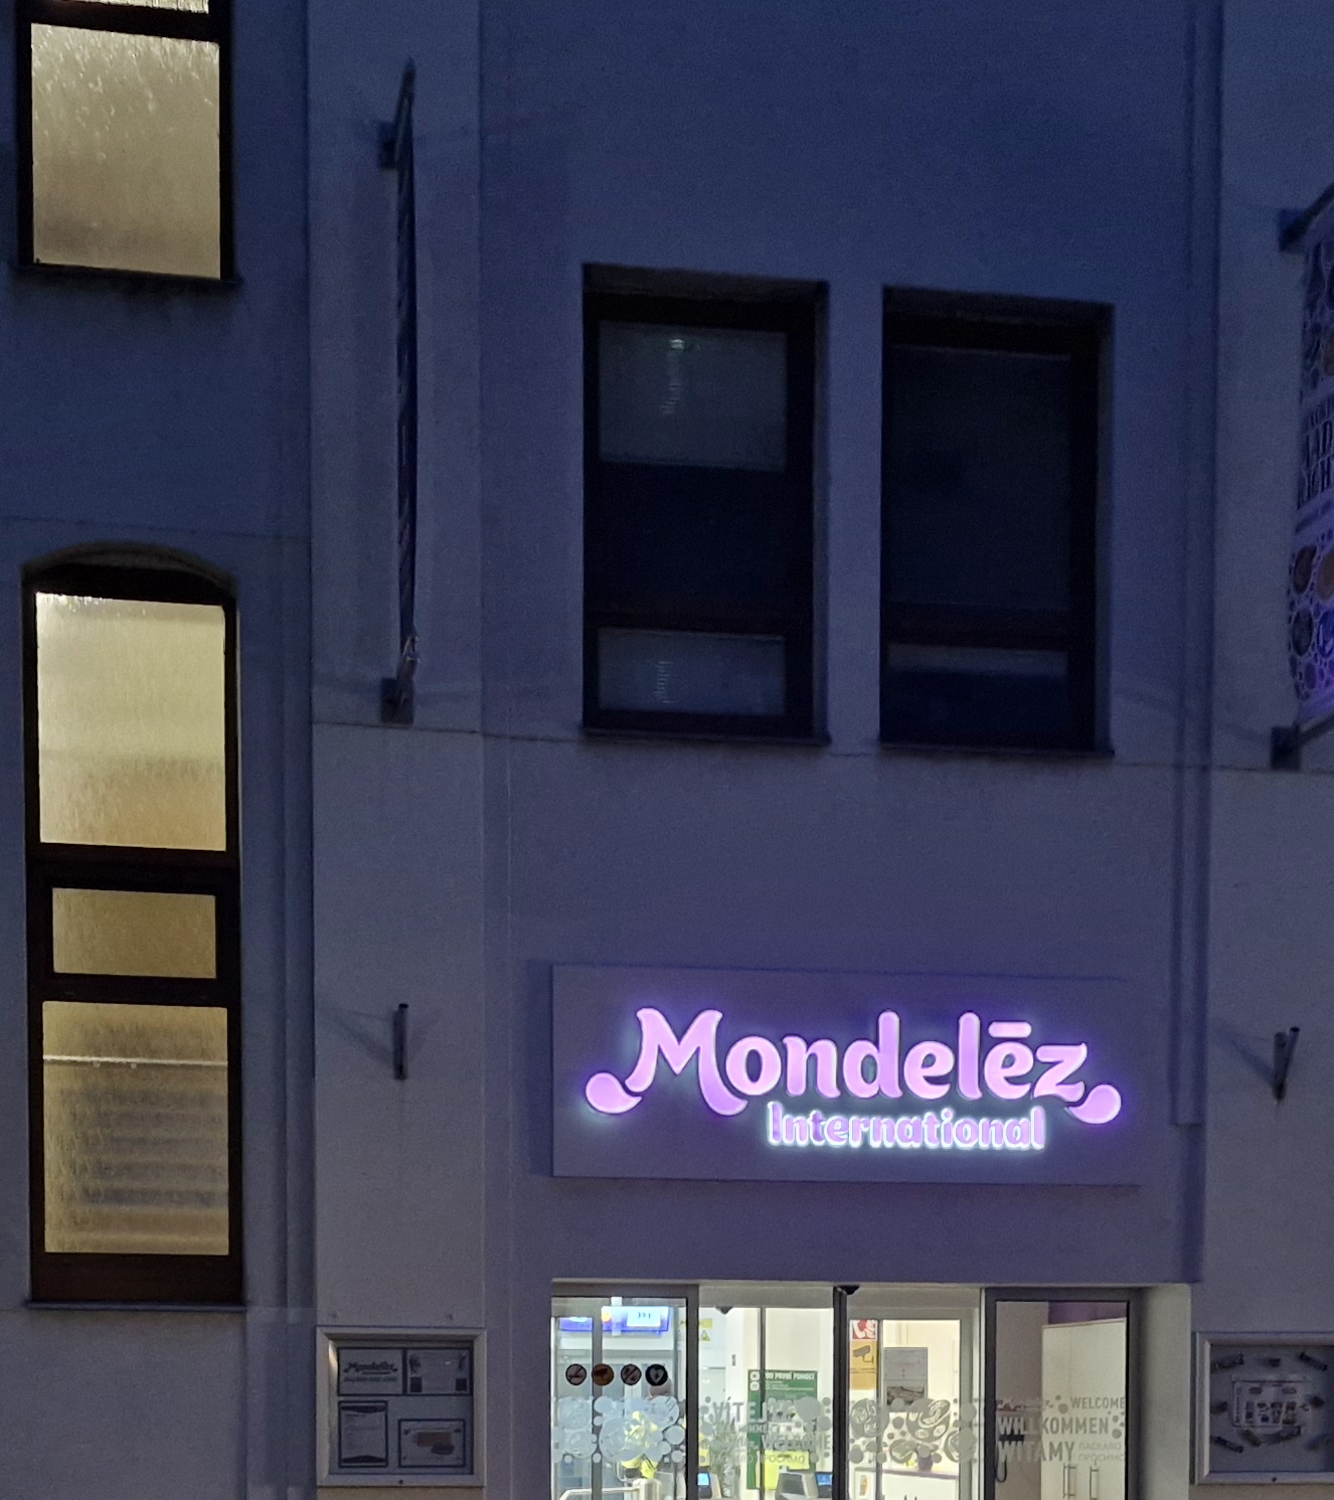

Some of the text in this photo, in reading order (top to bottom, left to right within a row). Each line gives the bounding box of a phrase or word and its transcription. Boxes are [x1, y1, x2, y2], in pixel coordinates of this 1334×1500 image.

[768, 1101, 1045, 1150] International
[1070, 1396, 1125, 1410] WELCOME
[997, 1416, 1109, 1435] WILLKOMMEN
[997, 1441, 1076, 1462] WITAMY
